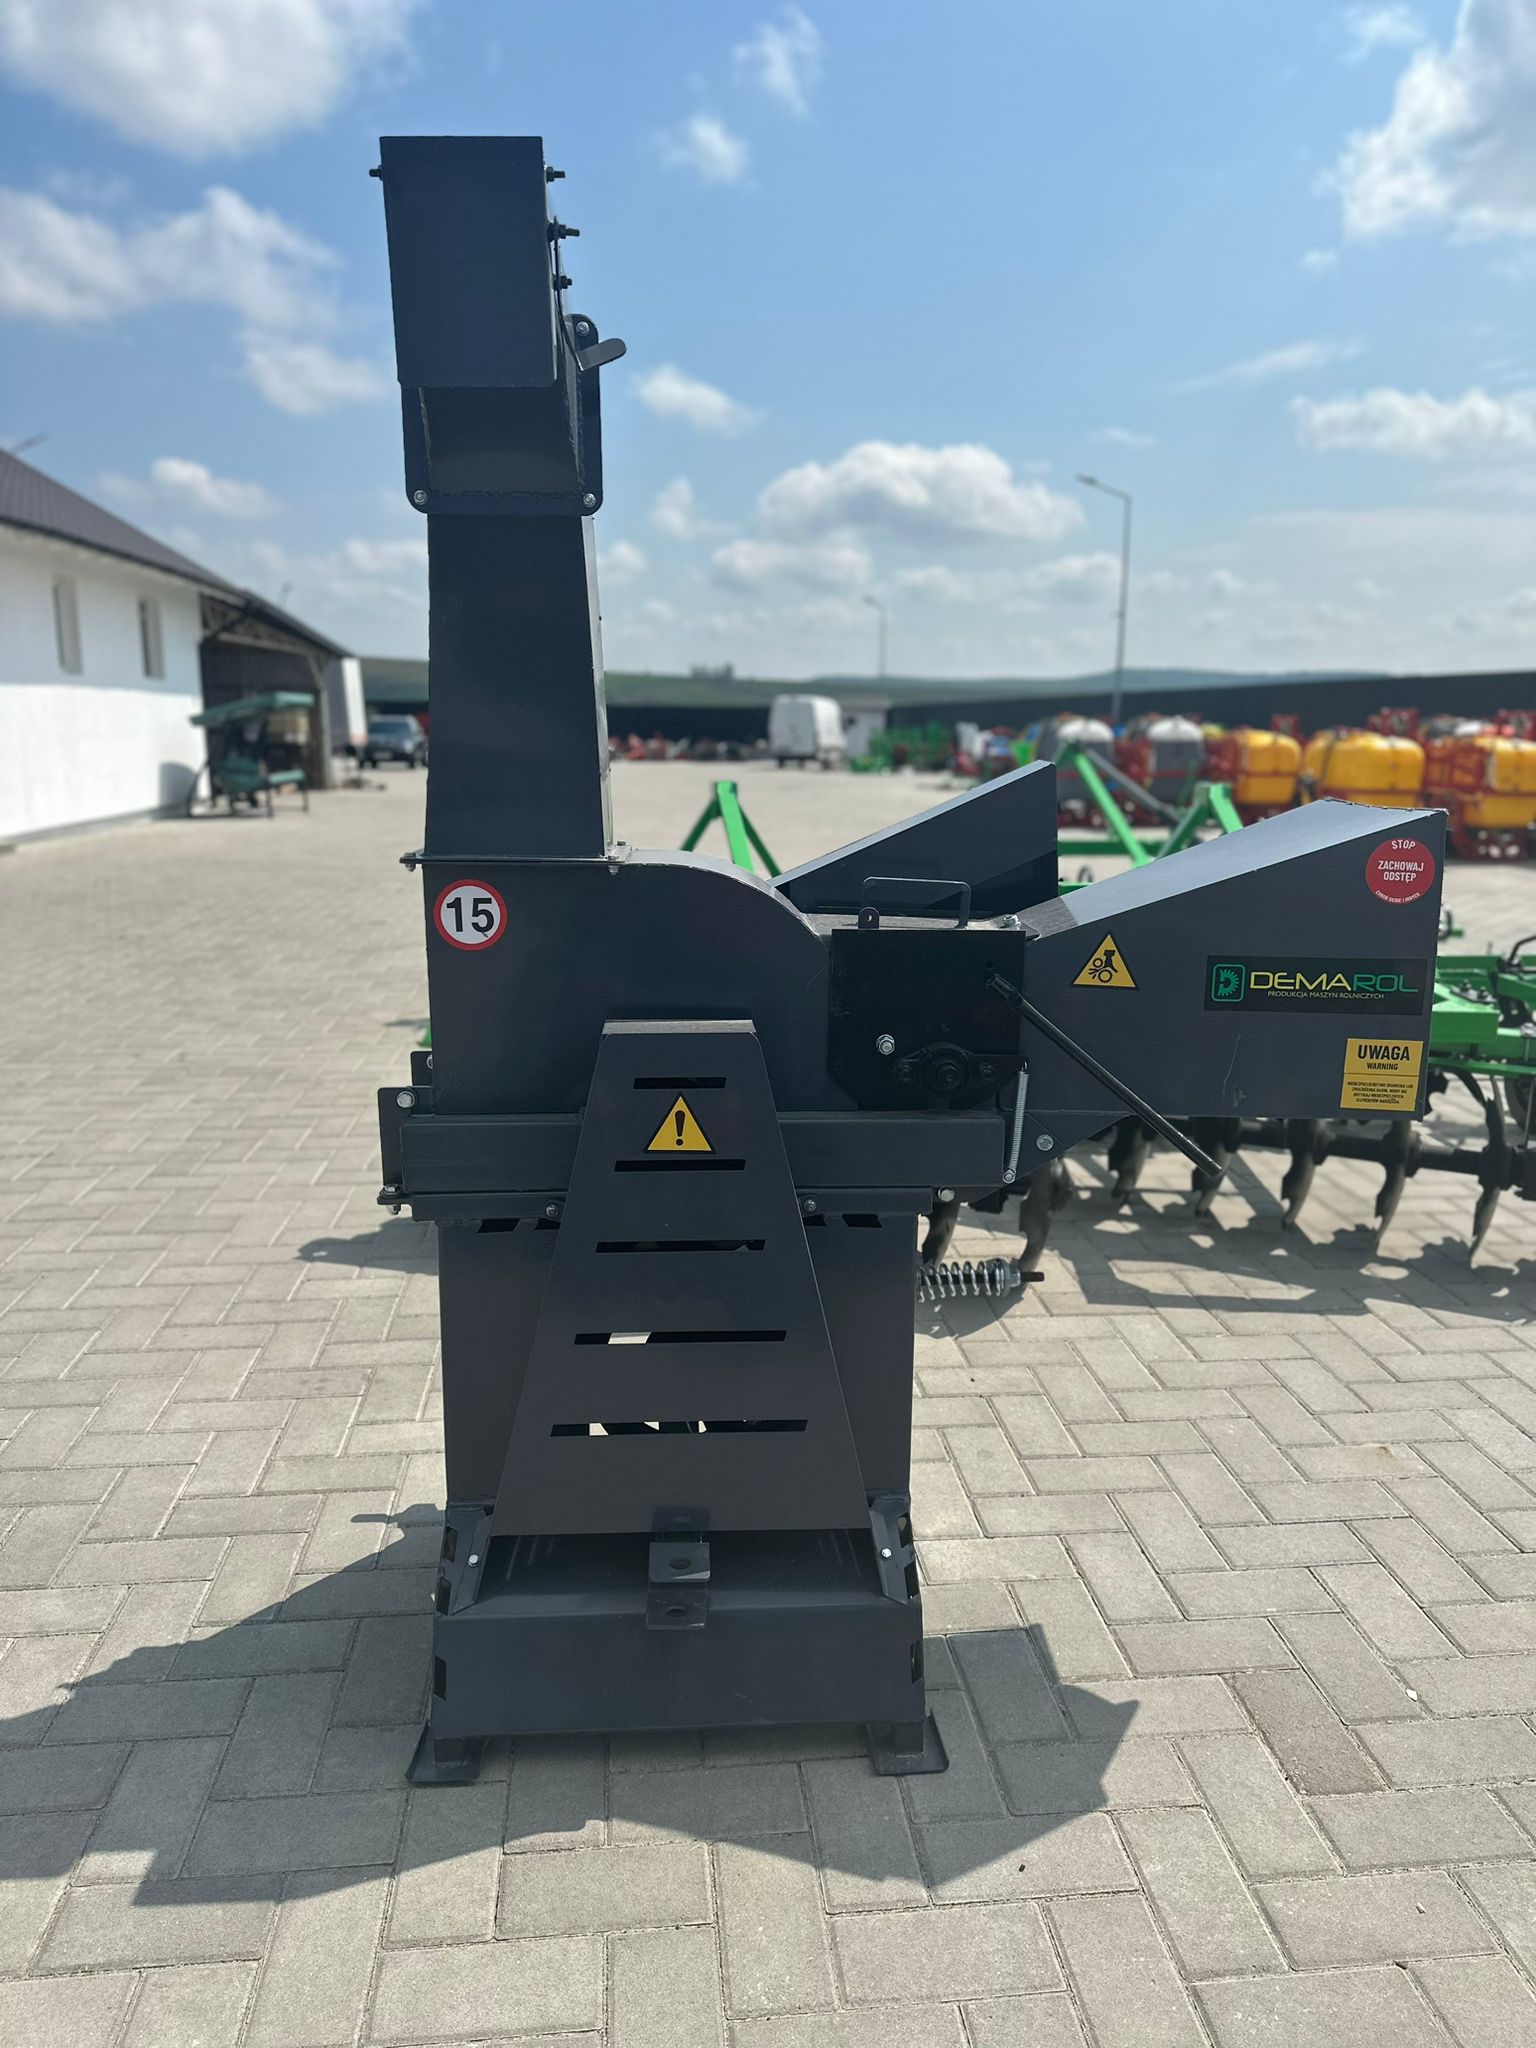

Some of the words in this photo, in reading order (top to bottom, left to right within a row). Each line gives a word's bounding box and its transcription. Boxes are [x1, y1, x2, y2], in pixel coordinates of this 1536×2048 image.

[1391, 839, 1416, 850] STOP
[1378, 860, 1424, 872] ZACHOWAJ
[1383, 871, 1417, 883] ODSTĘP
[446, 897, 494, 933] 15
[1249, 971, 1418, 993] DEMAROL
[1339, 991, 1384, 999] ROLNICZYCH
[1358, 1044, 1410, 1061] UWAGA
[1367, 1062, 1398, 1071] WARNING
